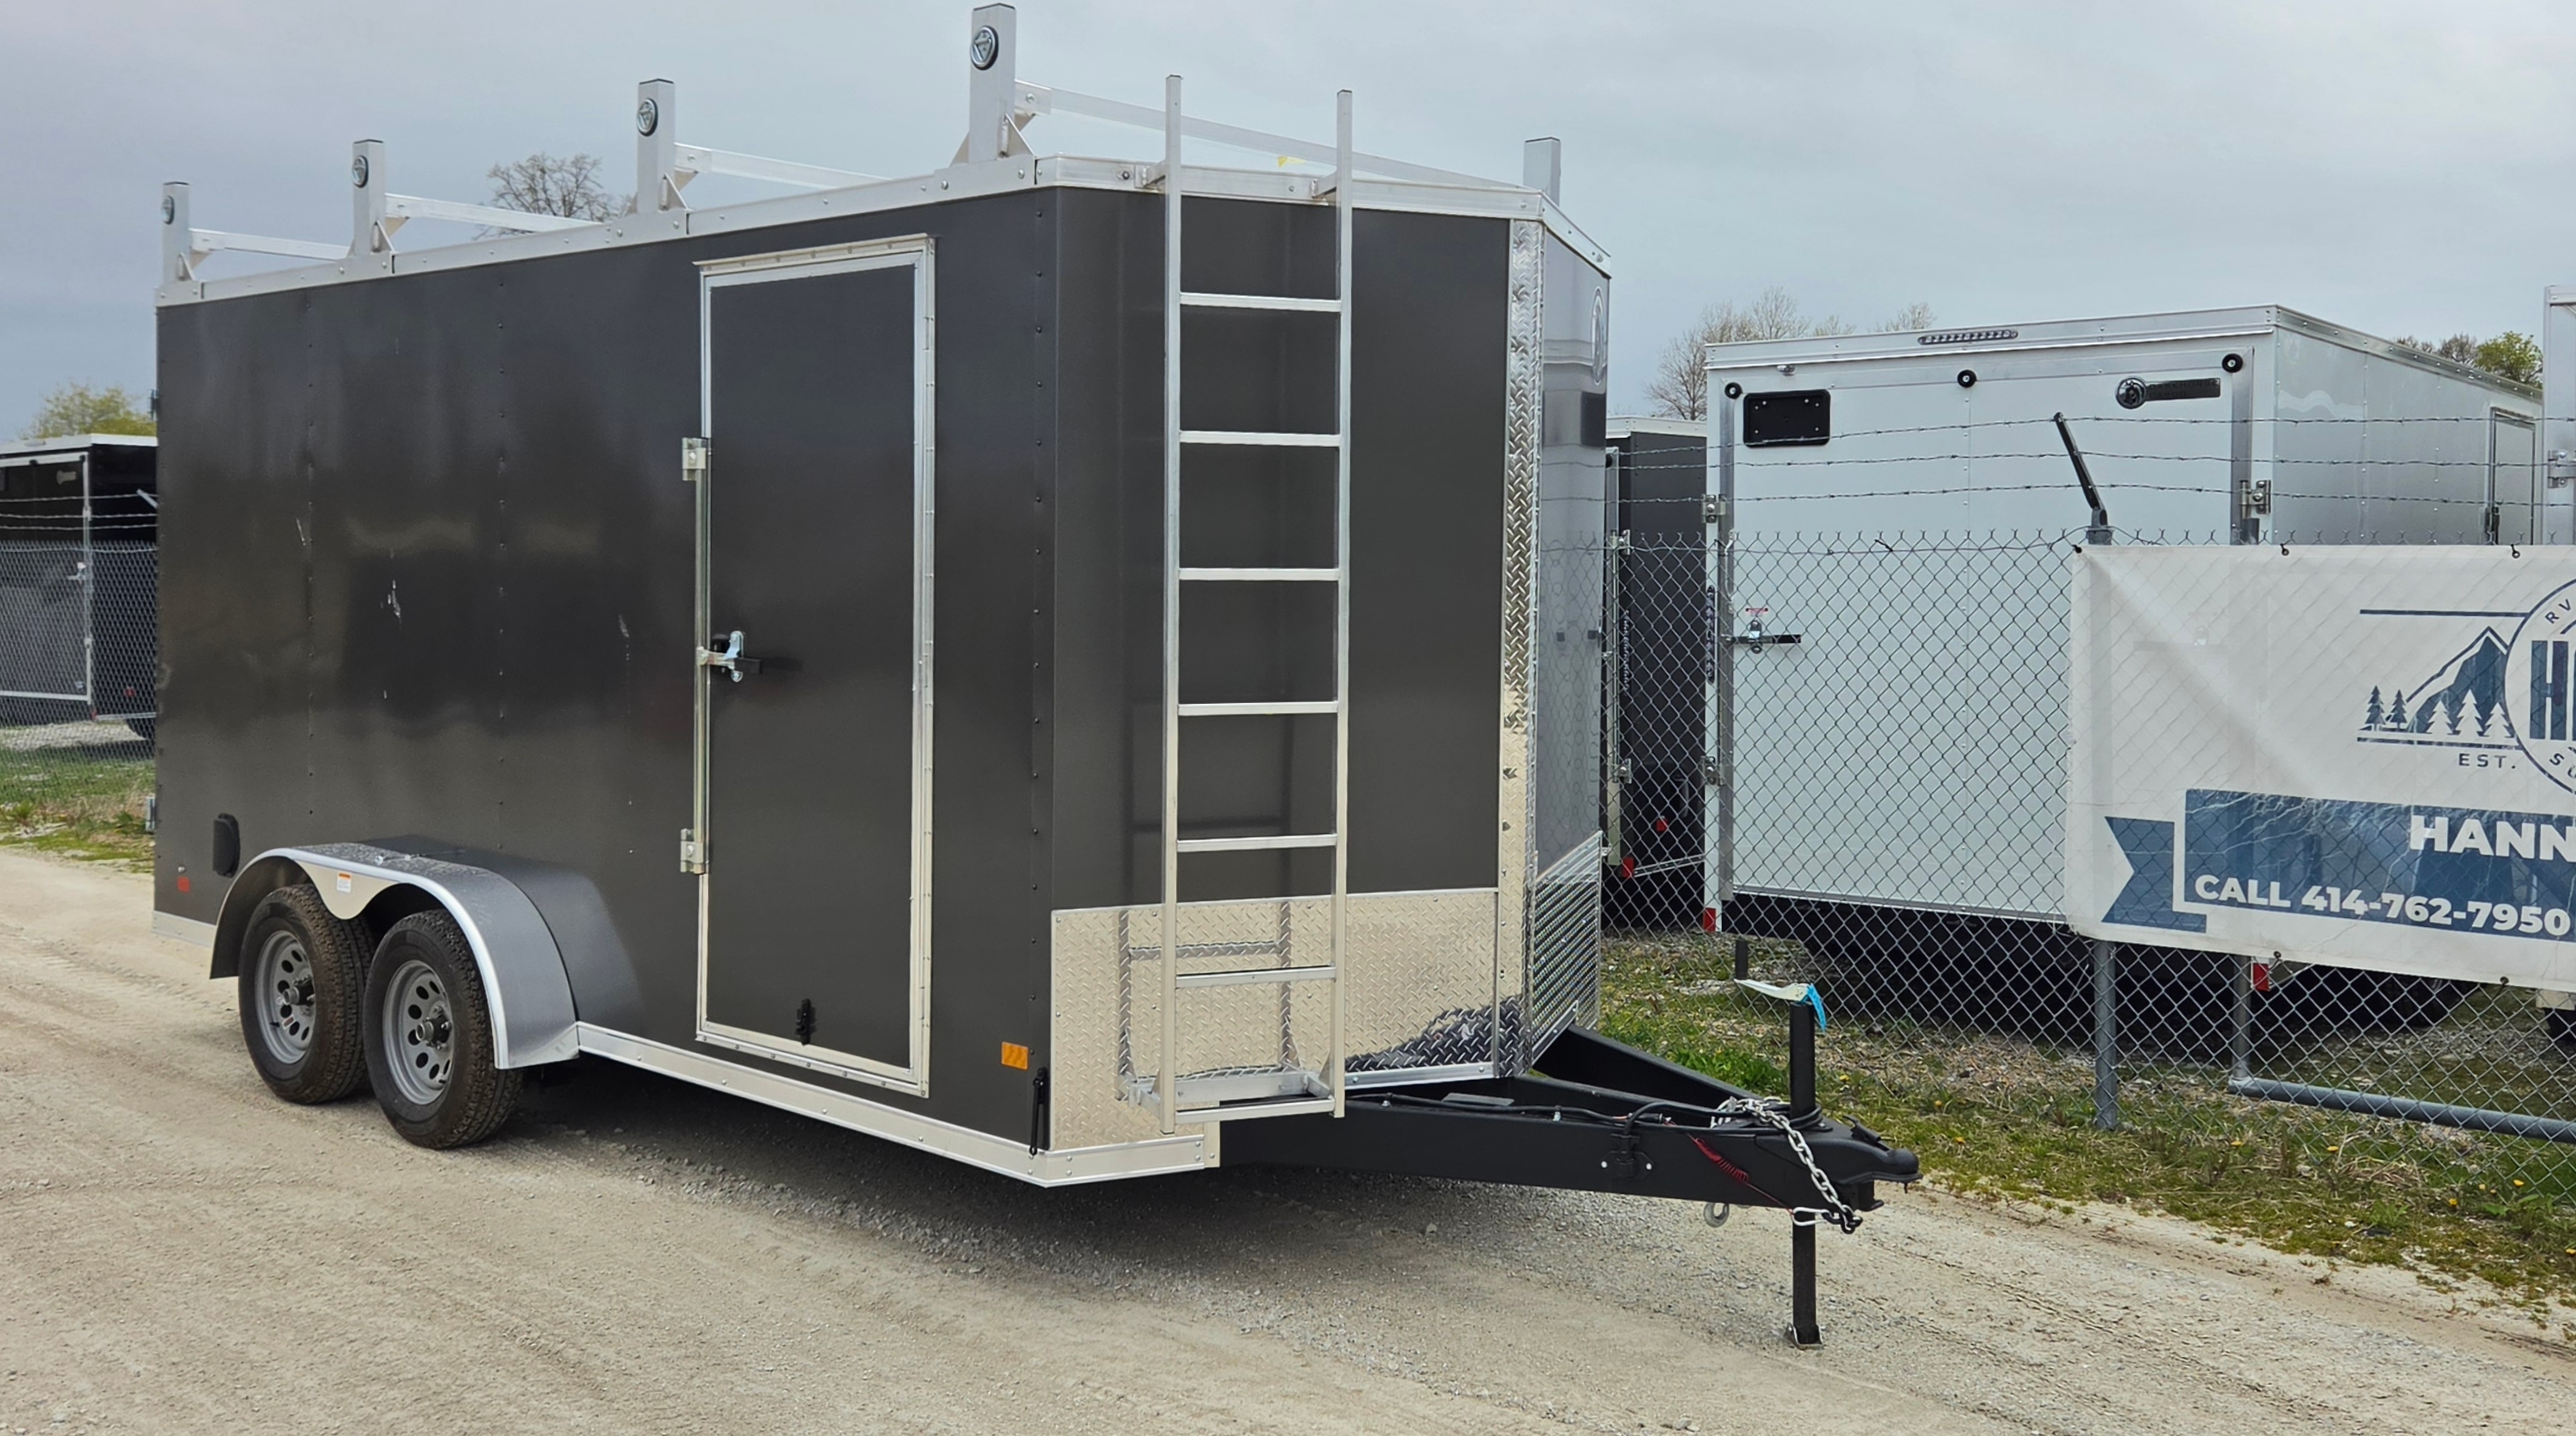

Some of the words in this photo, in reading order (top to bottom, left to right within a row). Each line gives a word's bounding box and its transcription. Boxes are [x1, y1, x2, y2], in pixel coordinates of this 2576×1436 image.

[2544, 598, 2572, 625] RV
[2529, 640, 2576, 741] H
[2458, 753, 2516, 769] EST.
[2195, 874, 2291, 908] CALL
[2301, 885, 2572, 936] 414-762-7950
